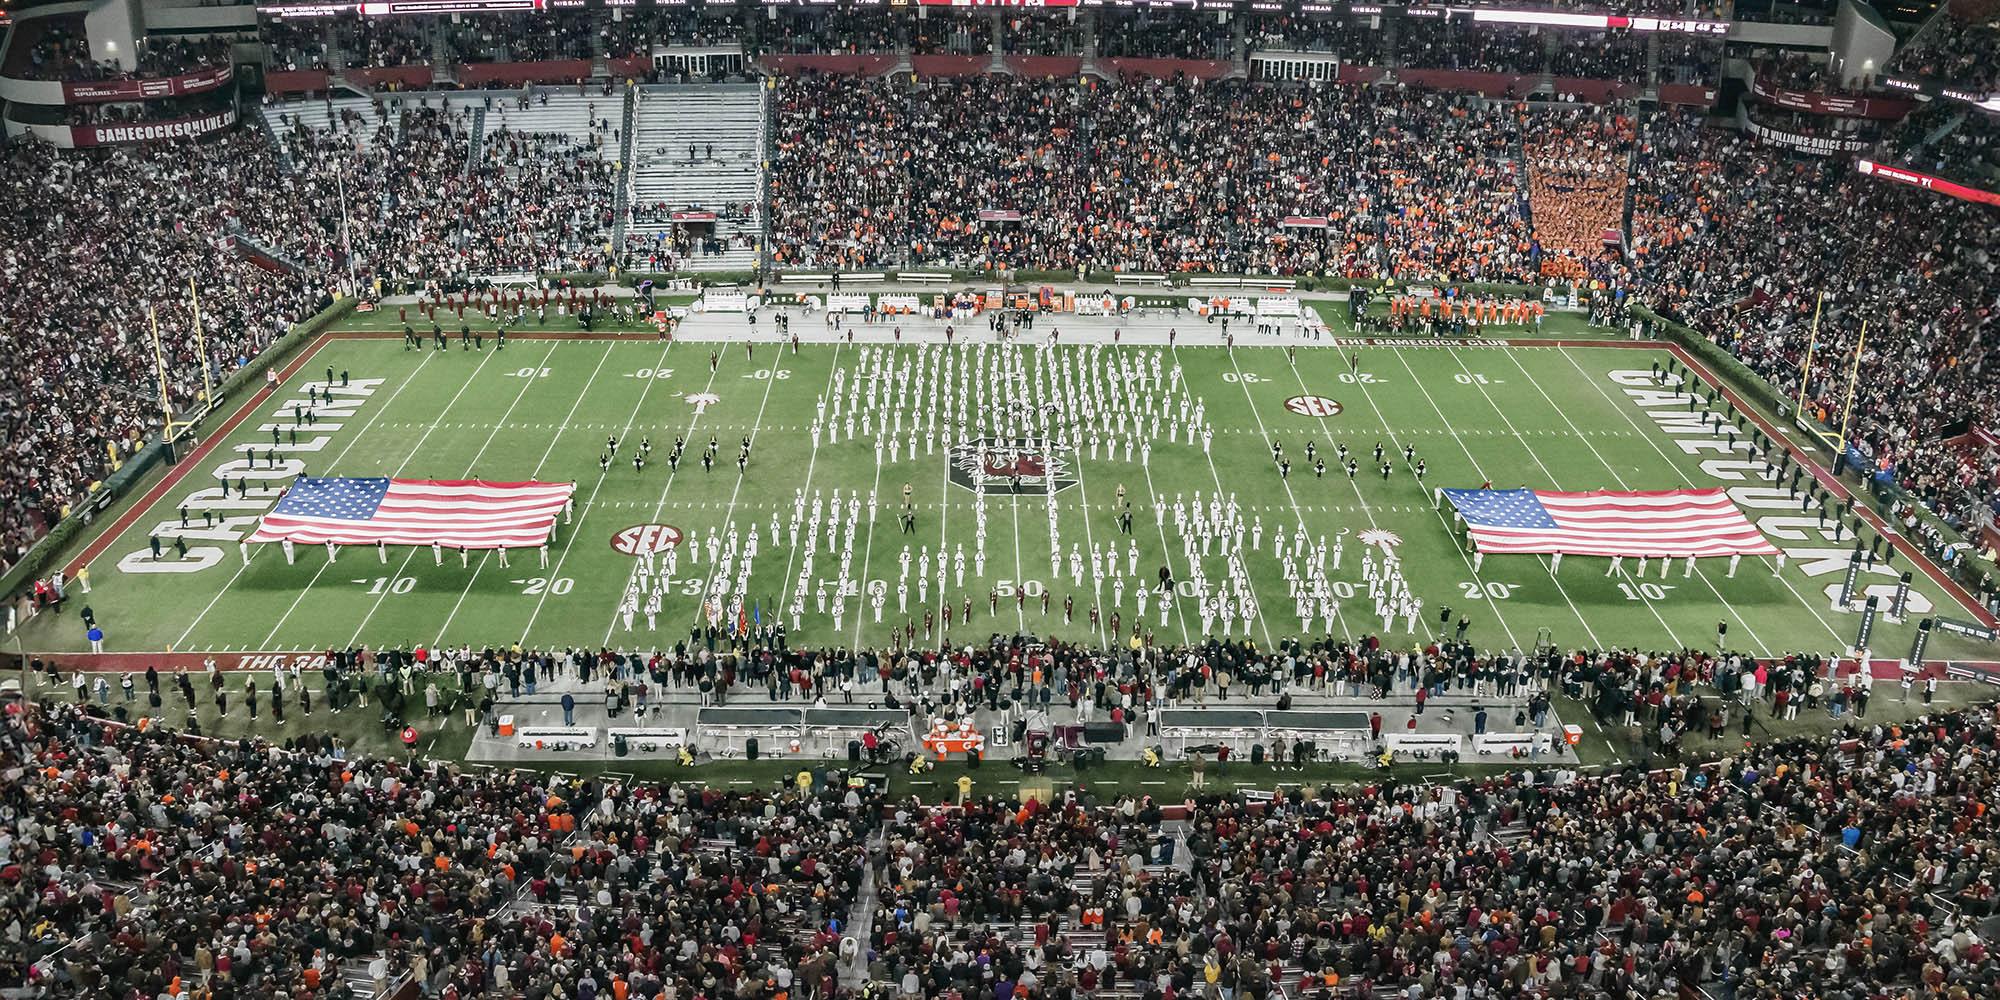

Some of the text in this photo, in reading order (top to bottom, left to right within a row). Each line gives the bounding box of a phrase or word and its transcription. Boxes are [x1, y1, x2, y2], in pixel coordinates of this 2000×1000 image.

[1886, 79, 1920, 91] NISSAN
[1761, 127, 1769, 138] TO
[1770, 130, 1842, 151] WILLIAMS-BRICE
[1795, 145, 1833, 156] GAMECOCKS
[1373, 338, 1462, 347] GAMECOCK
[1465, 339, 1509, 347] CLUB
[516, 367, 552, 378] 10
[635, 368, 675, 379] 20
[754, 369, 792, 380] 30
[1222, 372, 1260, 383] 30
[1338, 373, 1376, 384] 20
[1454, 374, 1489, 384] 10
[1287, 396, 1341, 417] SEC
[117, 378, 387, 574] CAROLINA
[1607, 369, 1935, 614] GAMECOCKS
[614, 525, 679, 555] SEC
[366, 577, 417, 595] 10
[521, 577, 575, 595] 20
[996, 579, 1044, 597] 50
[1457, 582, 1511, 599] 20
[1616, 583, 1667, 600] 10
[237, 655, 287, 670] THE
